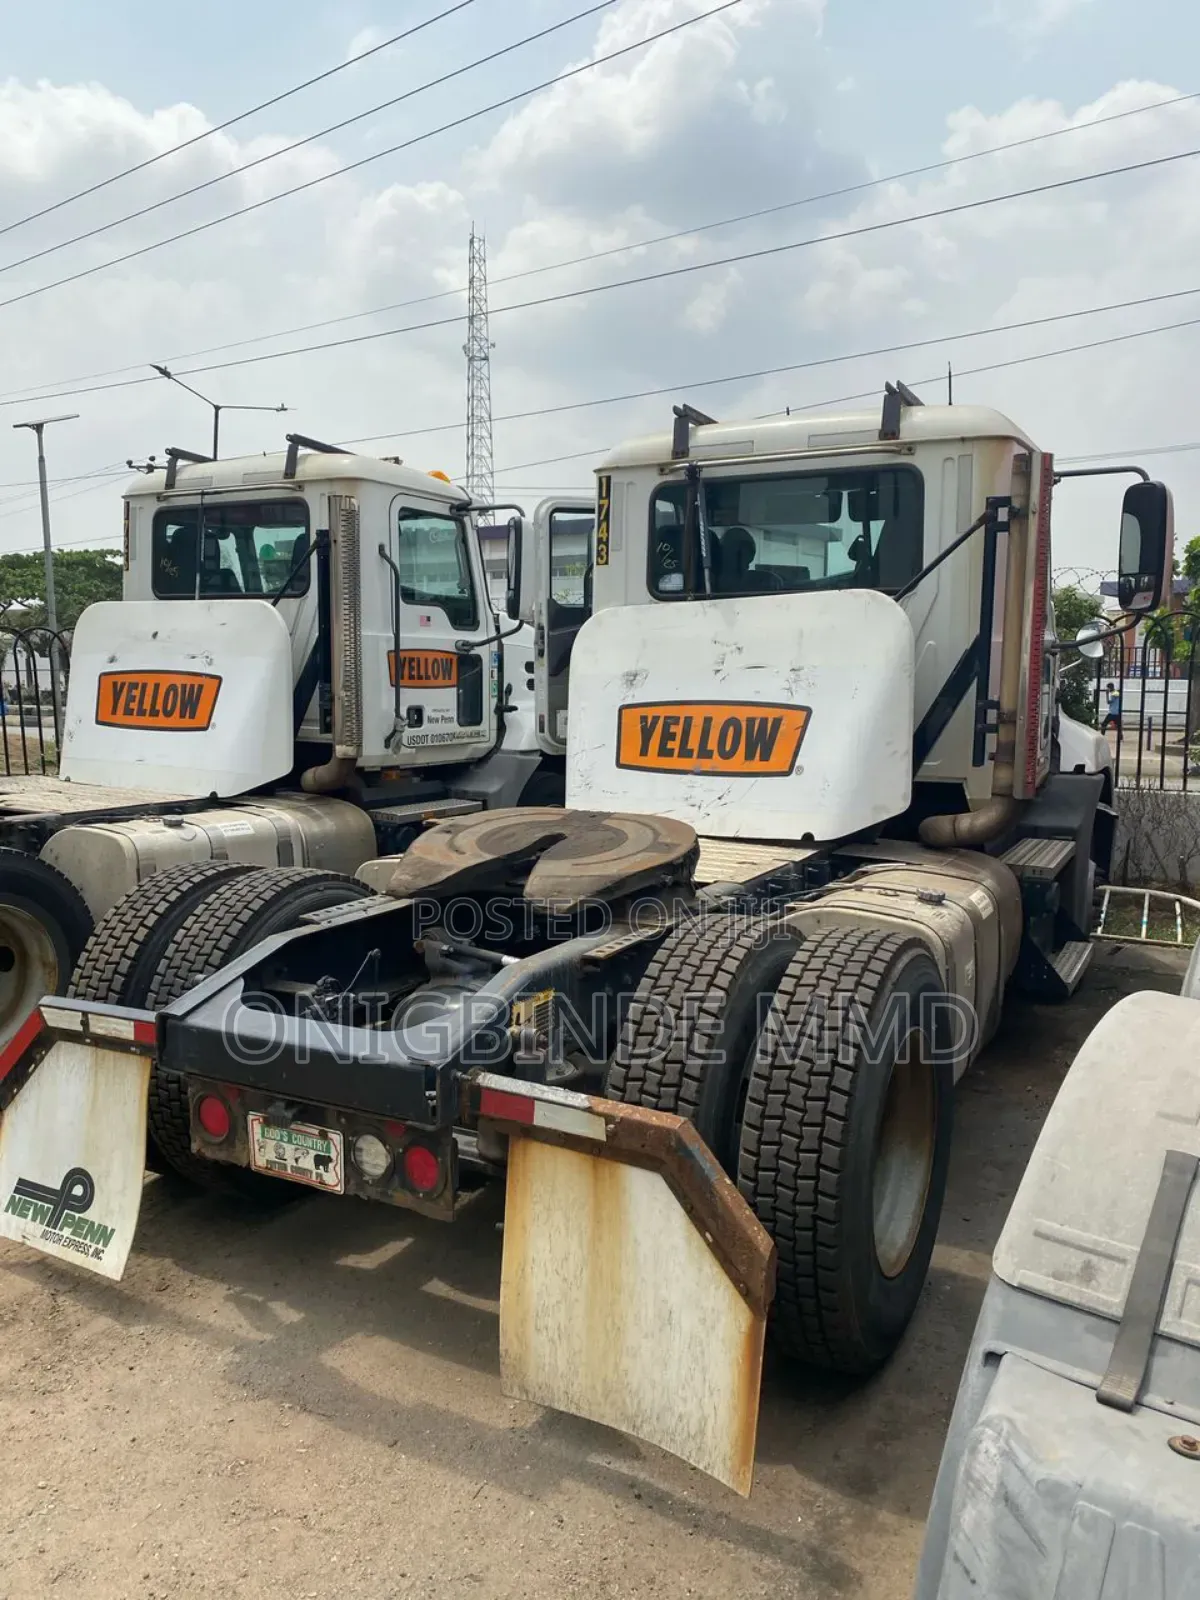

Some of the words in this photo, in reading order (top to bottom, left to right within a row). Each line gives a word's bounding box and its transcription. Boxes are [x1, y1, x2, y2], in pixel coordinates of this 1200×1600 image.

[597, 476, 610, 565] 1743
[399, 656, 453, 680] YELLOW
[110, 680, 205, 720] YELLOW
[427, 715, 440, 725] New
[441, 714, 455, 724] Penn
[407, 735, 429, 746] USDOT
[638, 714, 783, 762] YELLOW
[291, 1133, 329, 1154] COUNTRY
[4, 1194, 53, 1226] NEW
[59, 1211, 116, 1249] PENN
[40, 1229, 63, 1246] MOTOR
